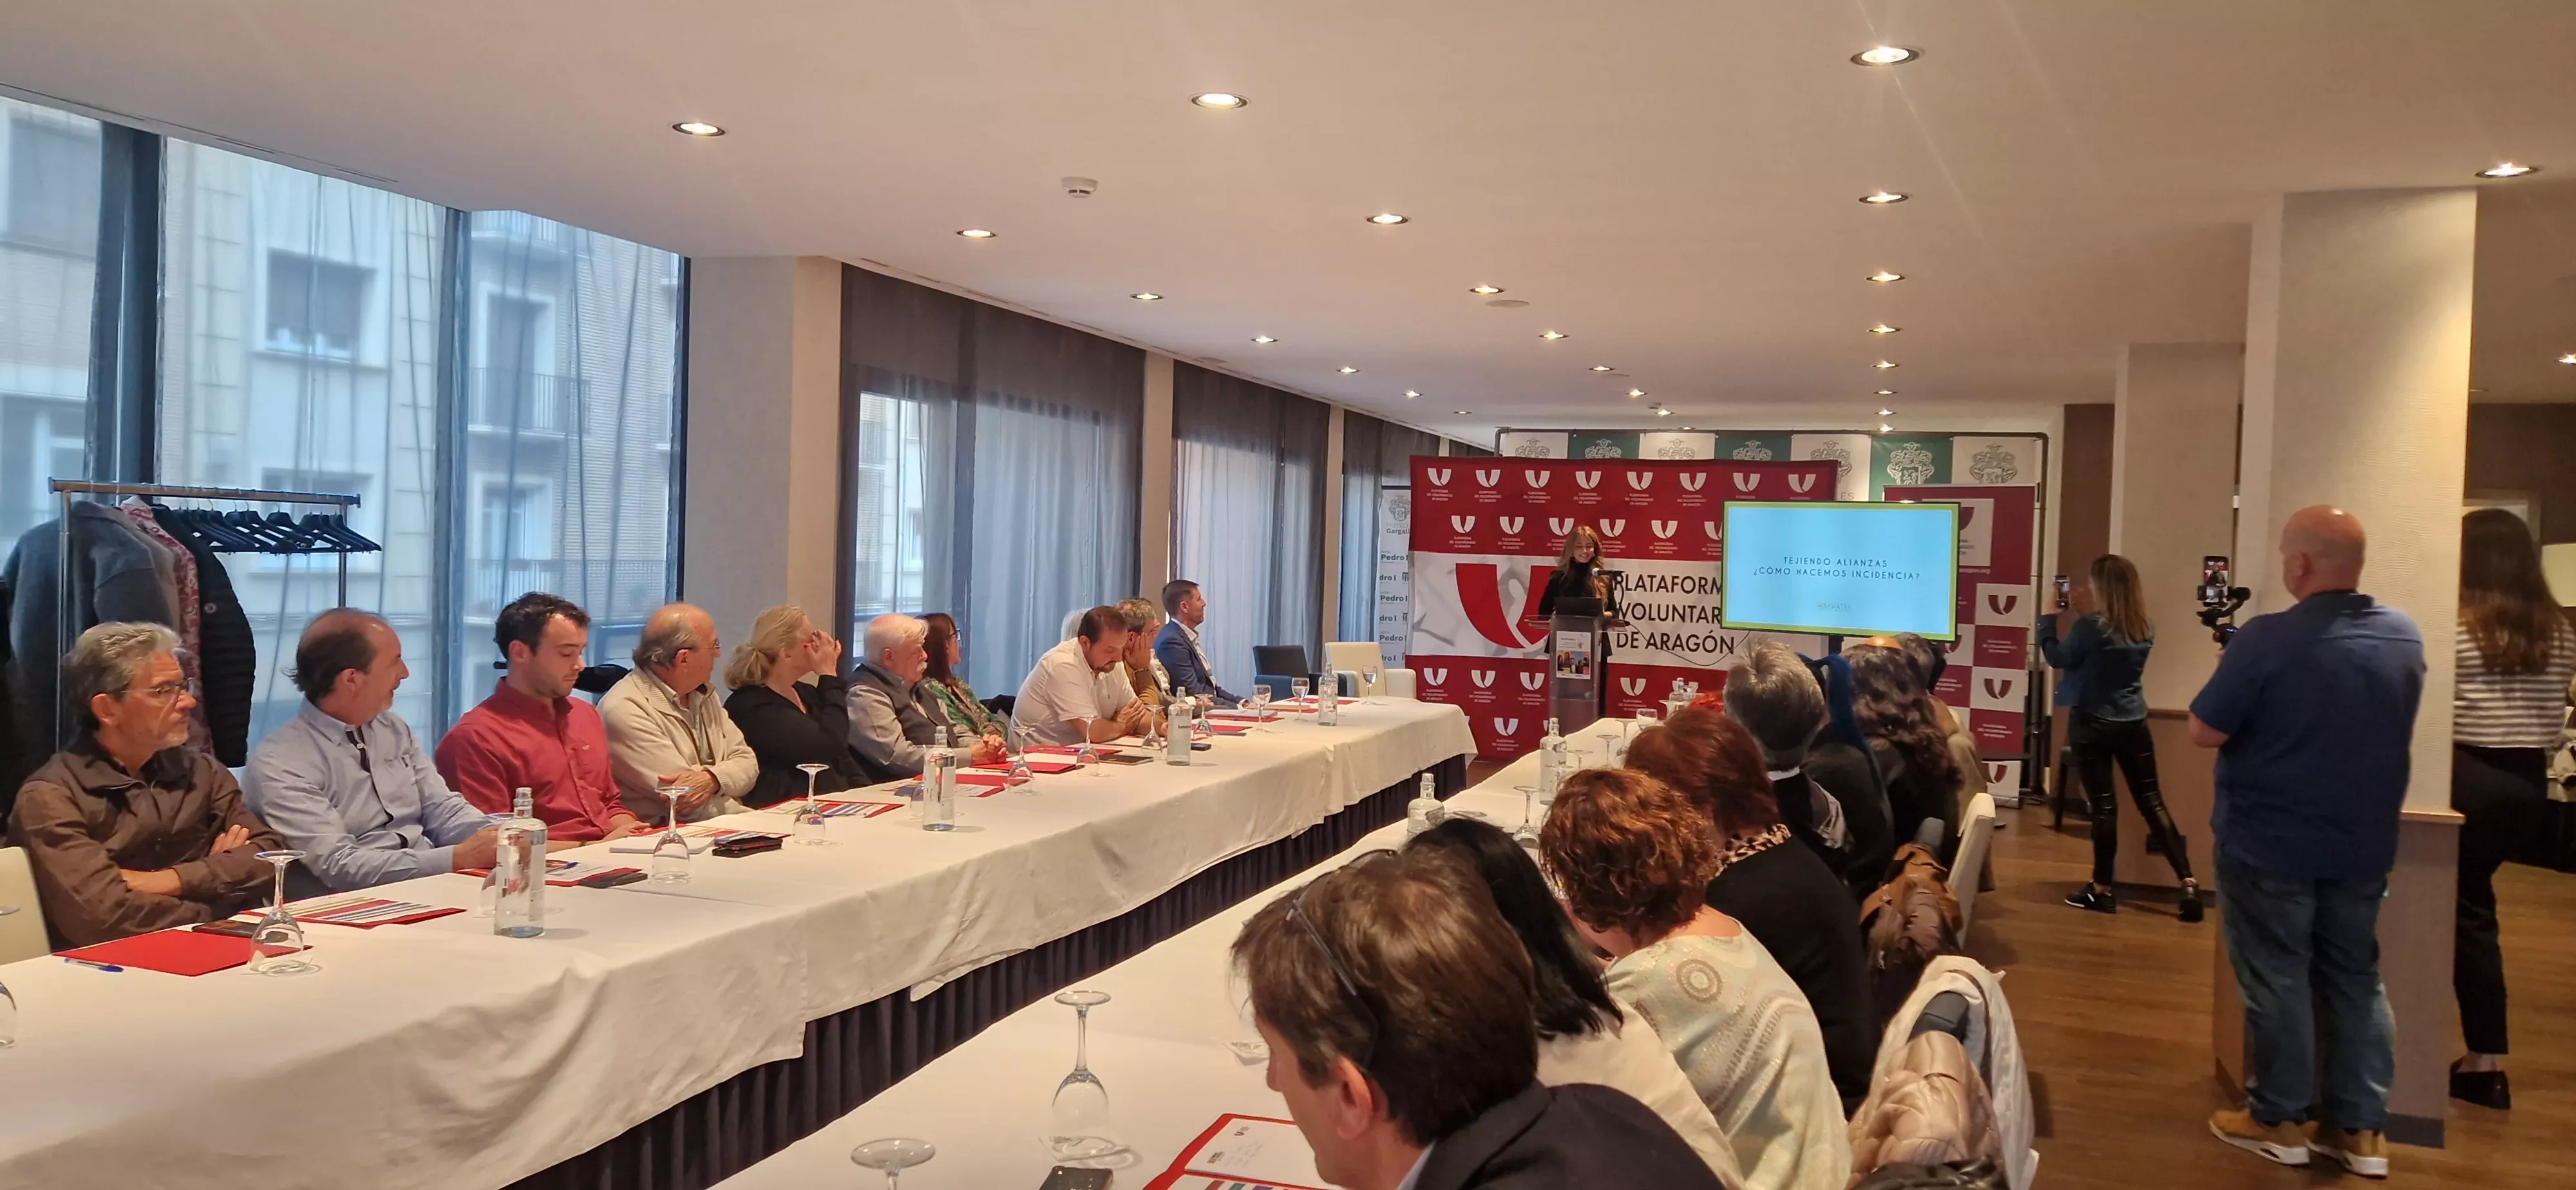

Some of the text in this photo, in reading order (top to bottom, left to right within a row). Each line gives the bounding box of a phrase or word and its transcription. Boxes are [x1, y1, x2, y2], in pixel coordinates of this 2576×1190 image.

[1784, 557, 1887, 567] TEJIENDO ALIANZAS
[1796, 569, 1846, 577] HACEMOS
[1852, 570, 1920, 580] INCIDENCIA?
[1616, 629, 1734, 654] DE ARAGÓN
